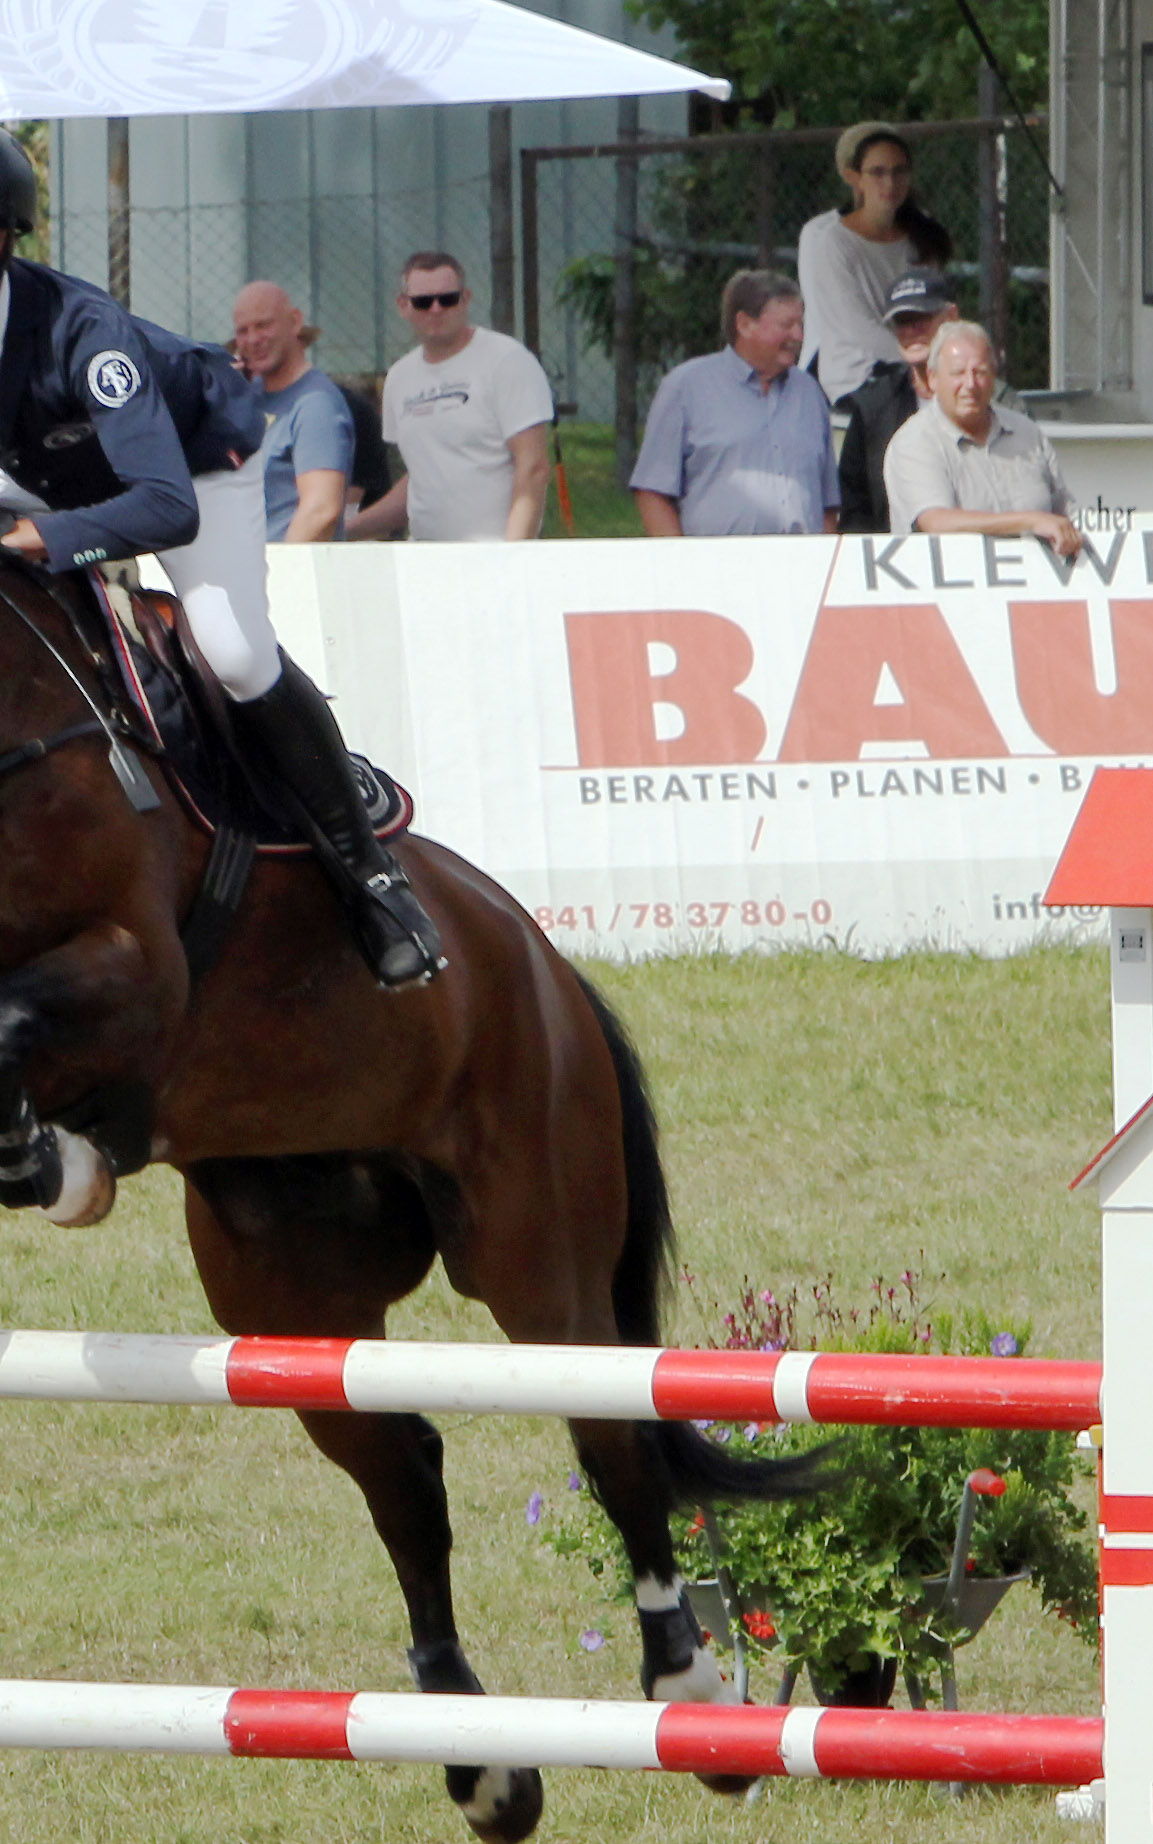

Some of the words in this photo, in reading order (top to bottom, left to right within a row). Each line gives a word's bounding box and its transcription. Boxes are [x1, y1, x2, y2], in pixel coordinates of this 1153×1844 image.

[563, 598, 1153, 768] BAU
[579, 771, 779, 805] BERATEN
[830, 765, 1008, 799] PLANEN
